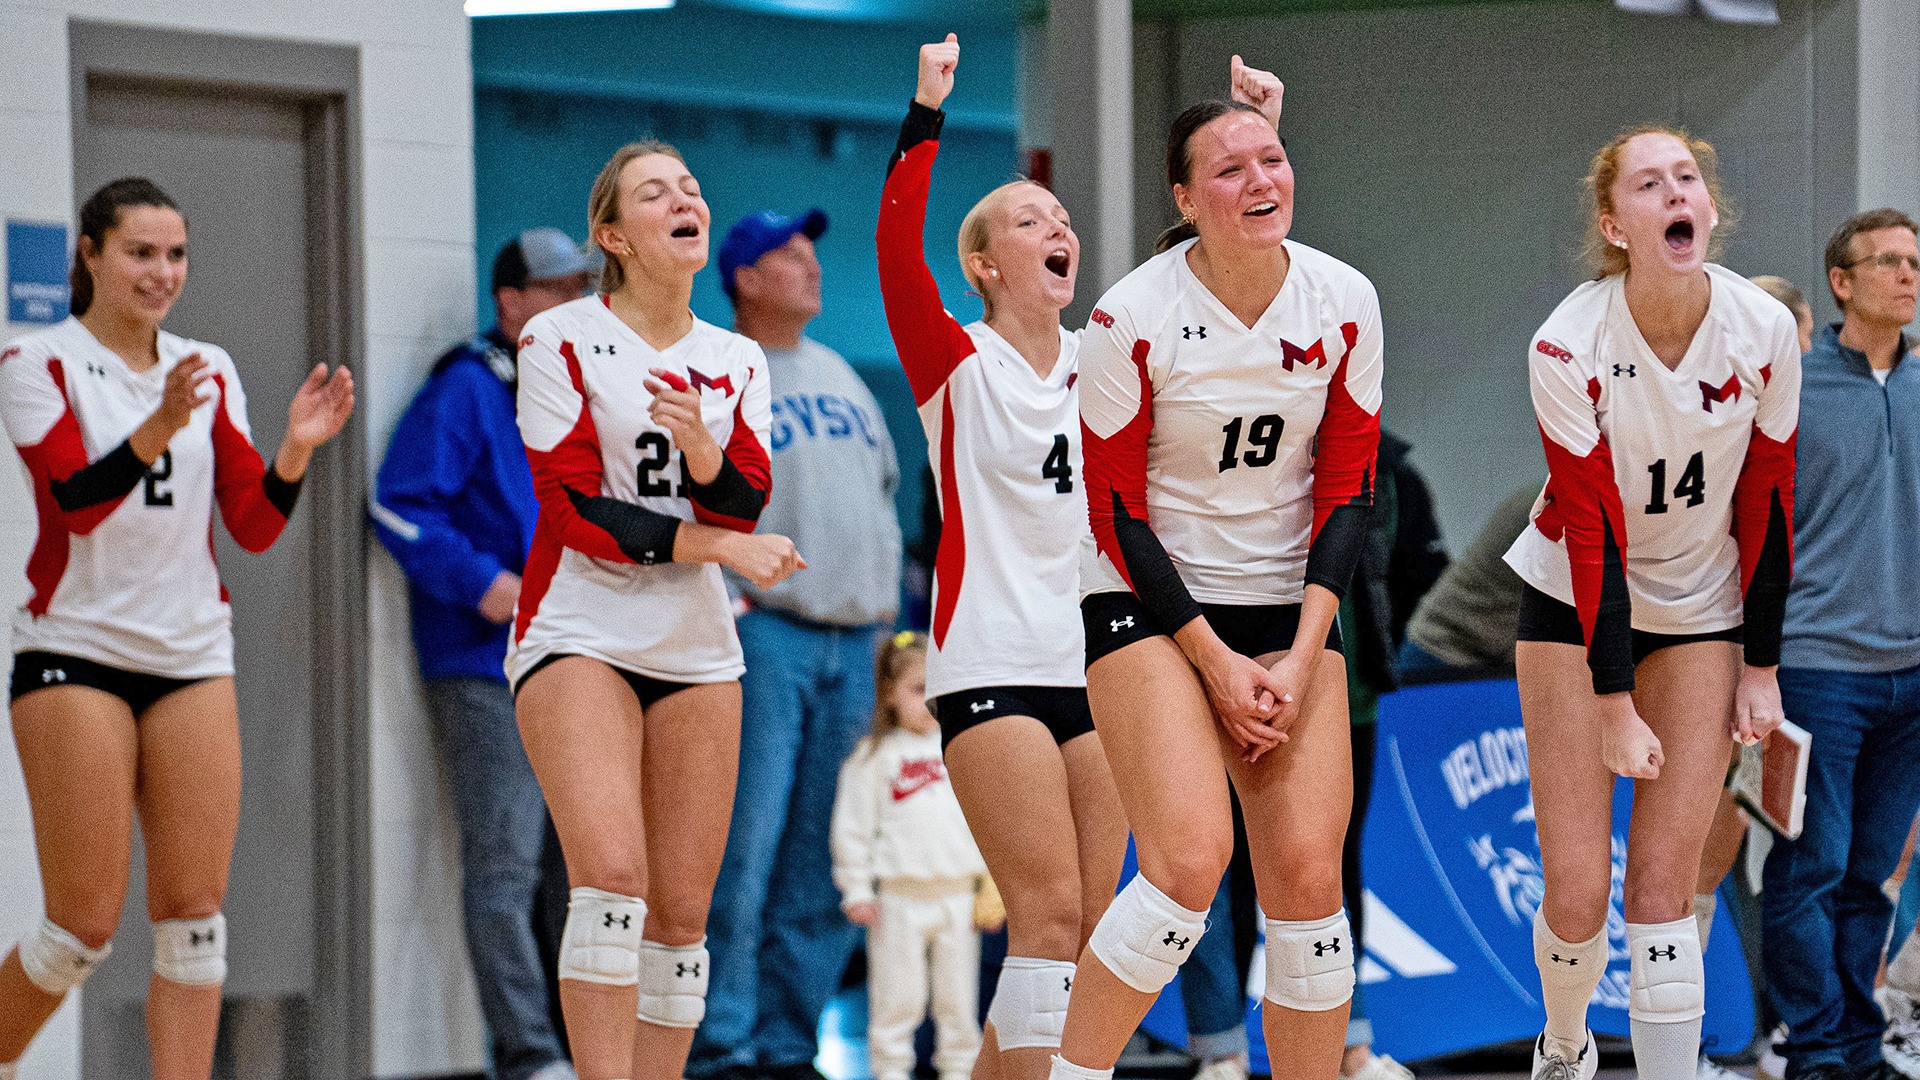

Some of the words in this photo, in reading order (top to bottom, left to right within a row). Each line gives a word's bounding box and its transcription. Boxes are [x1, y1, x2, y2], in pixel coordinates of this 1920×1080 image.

[1279, 337, 1328, 373] M
[1698, 371, 1743, 414] M
[1041, 433, 1073, 494] 4
[1218, 414, 1285, 473] 19
[1644, 450, 1706, 515] 14
